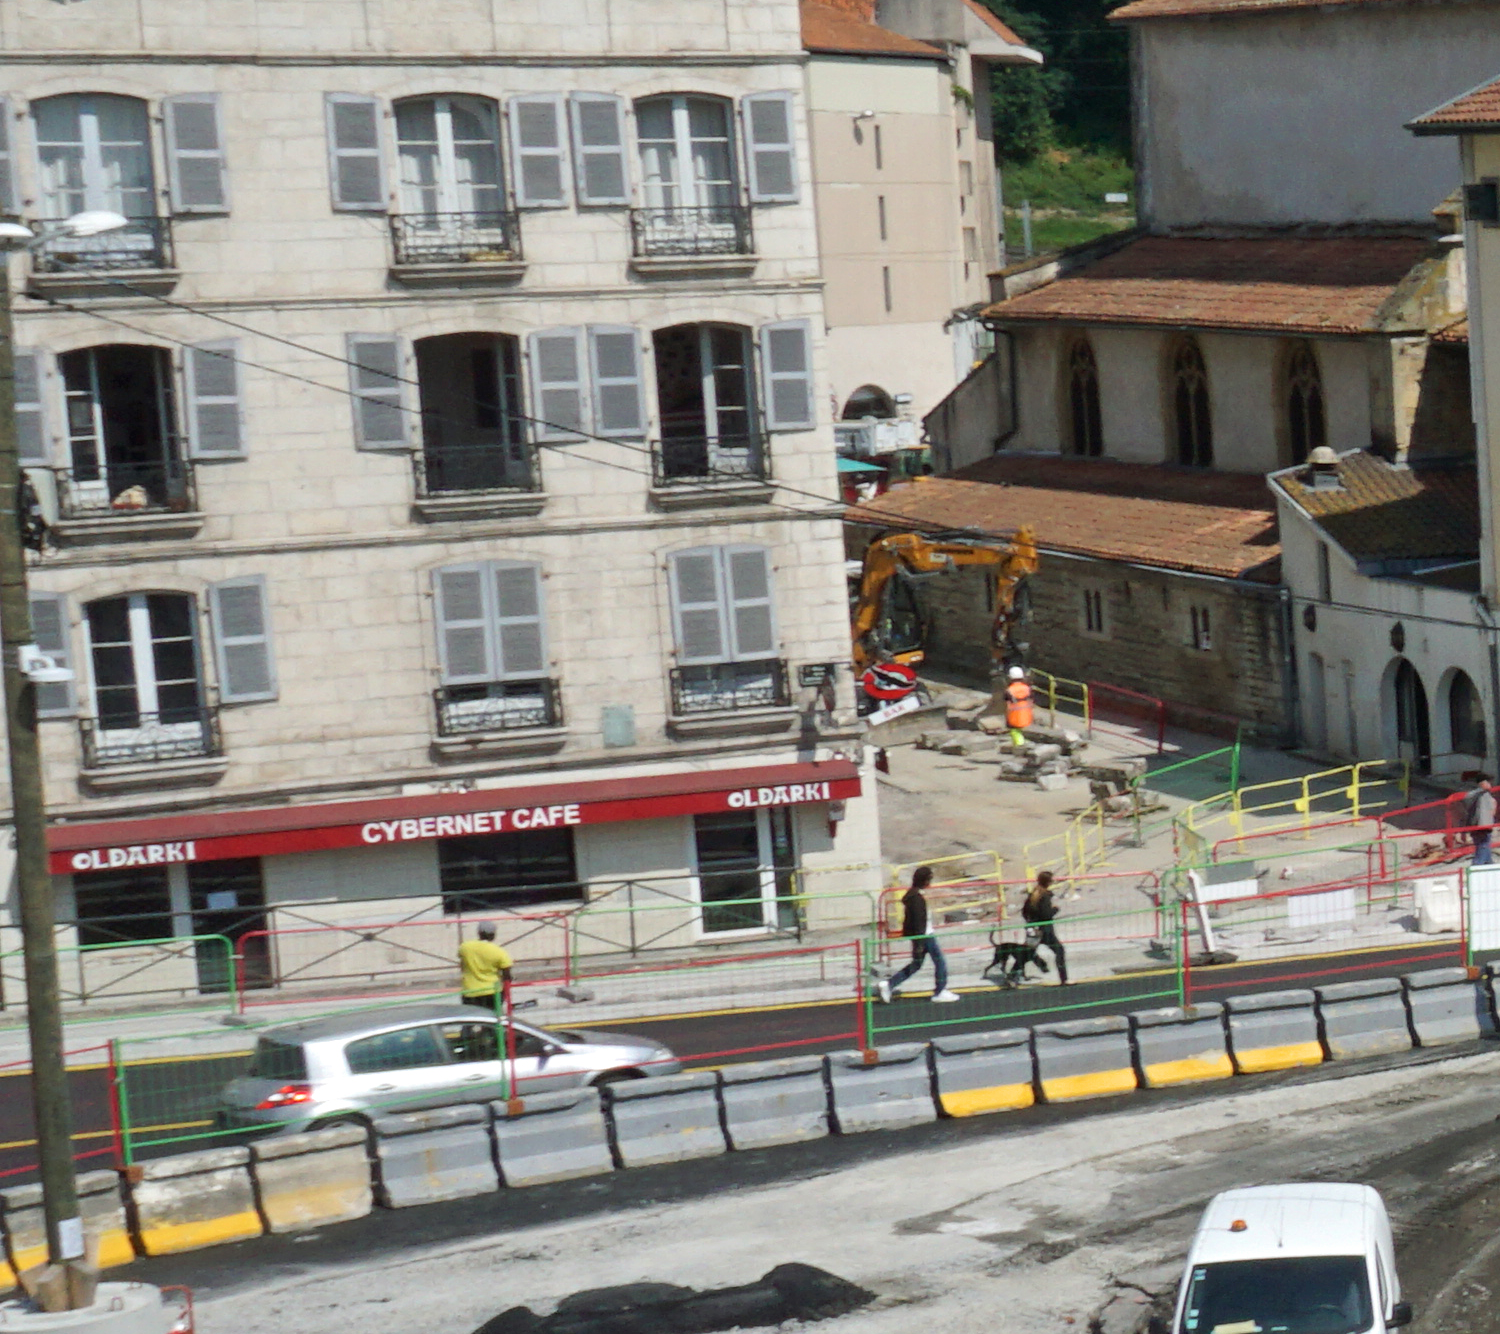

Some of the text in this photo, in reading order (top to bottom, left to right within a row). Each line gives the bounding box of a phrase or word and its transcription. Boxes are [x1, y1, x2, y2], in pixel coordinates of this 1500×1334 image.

[728, 782, 830, 808] OLDARKI
[362, 804, 581, 843] CYBERNET CAFE
[71, 841, 197, 870] OLDARKI
